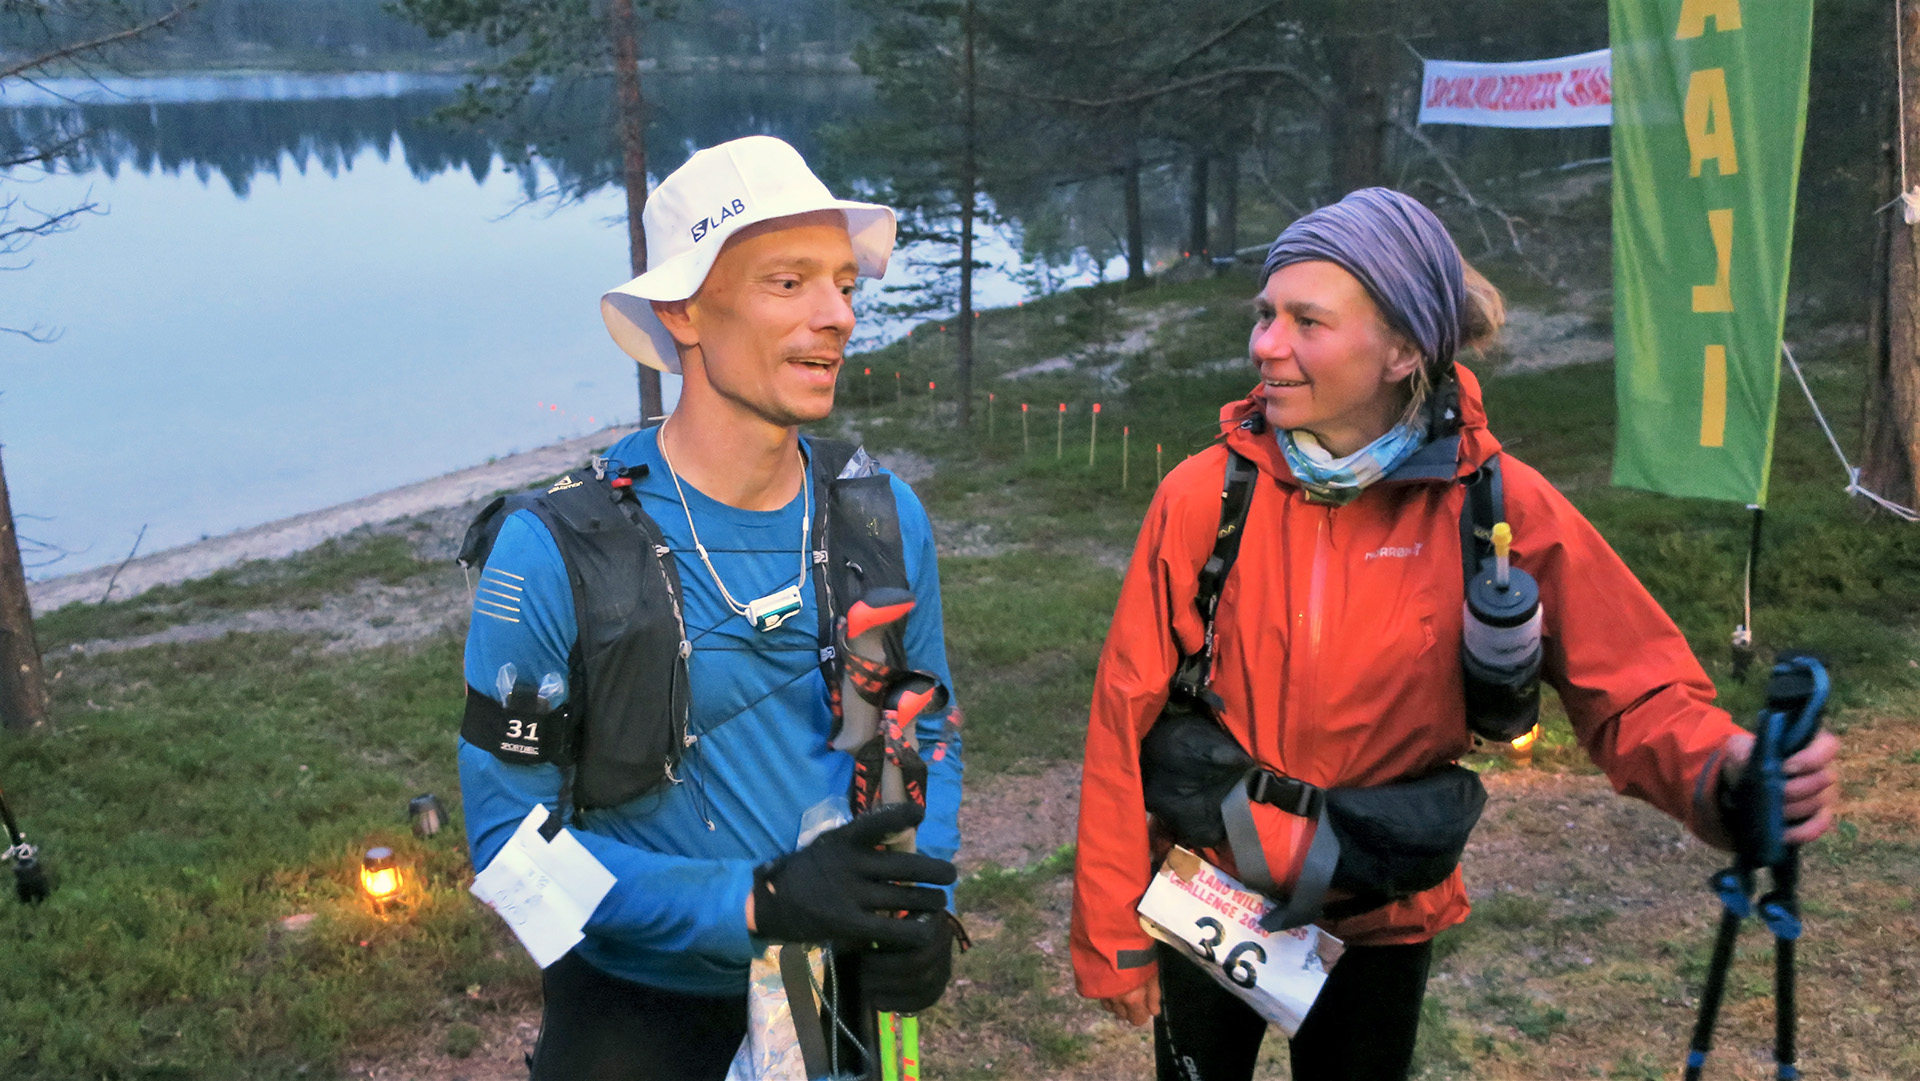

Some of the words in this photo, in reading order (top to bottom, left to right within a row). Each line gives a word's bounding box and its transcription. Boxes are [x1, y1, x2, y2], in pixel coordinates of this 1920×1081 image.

[506, 719, 539, 741] 31
[1197, 867, 1231, 895] LAND
[1195, 916, 1267, 989] 36
